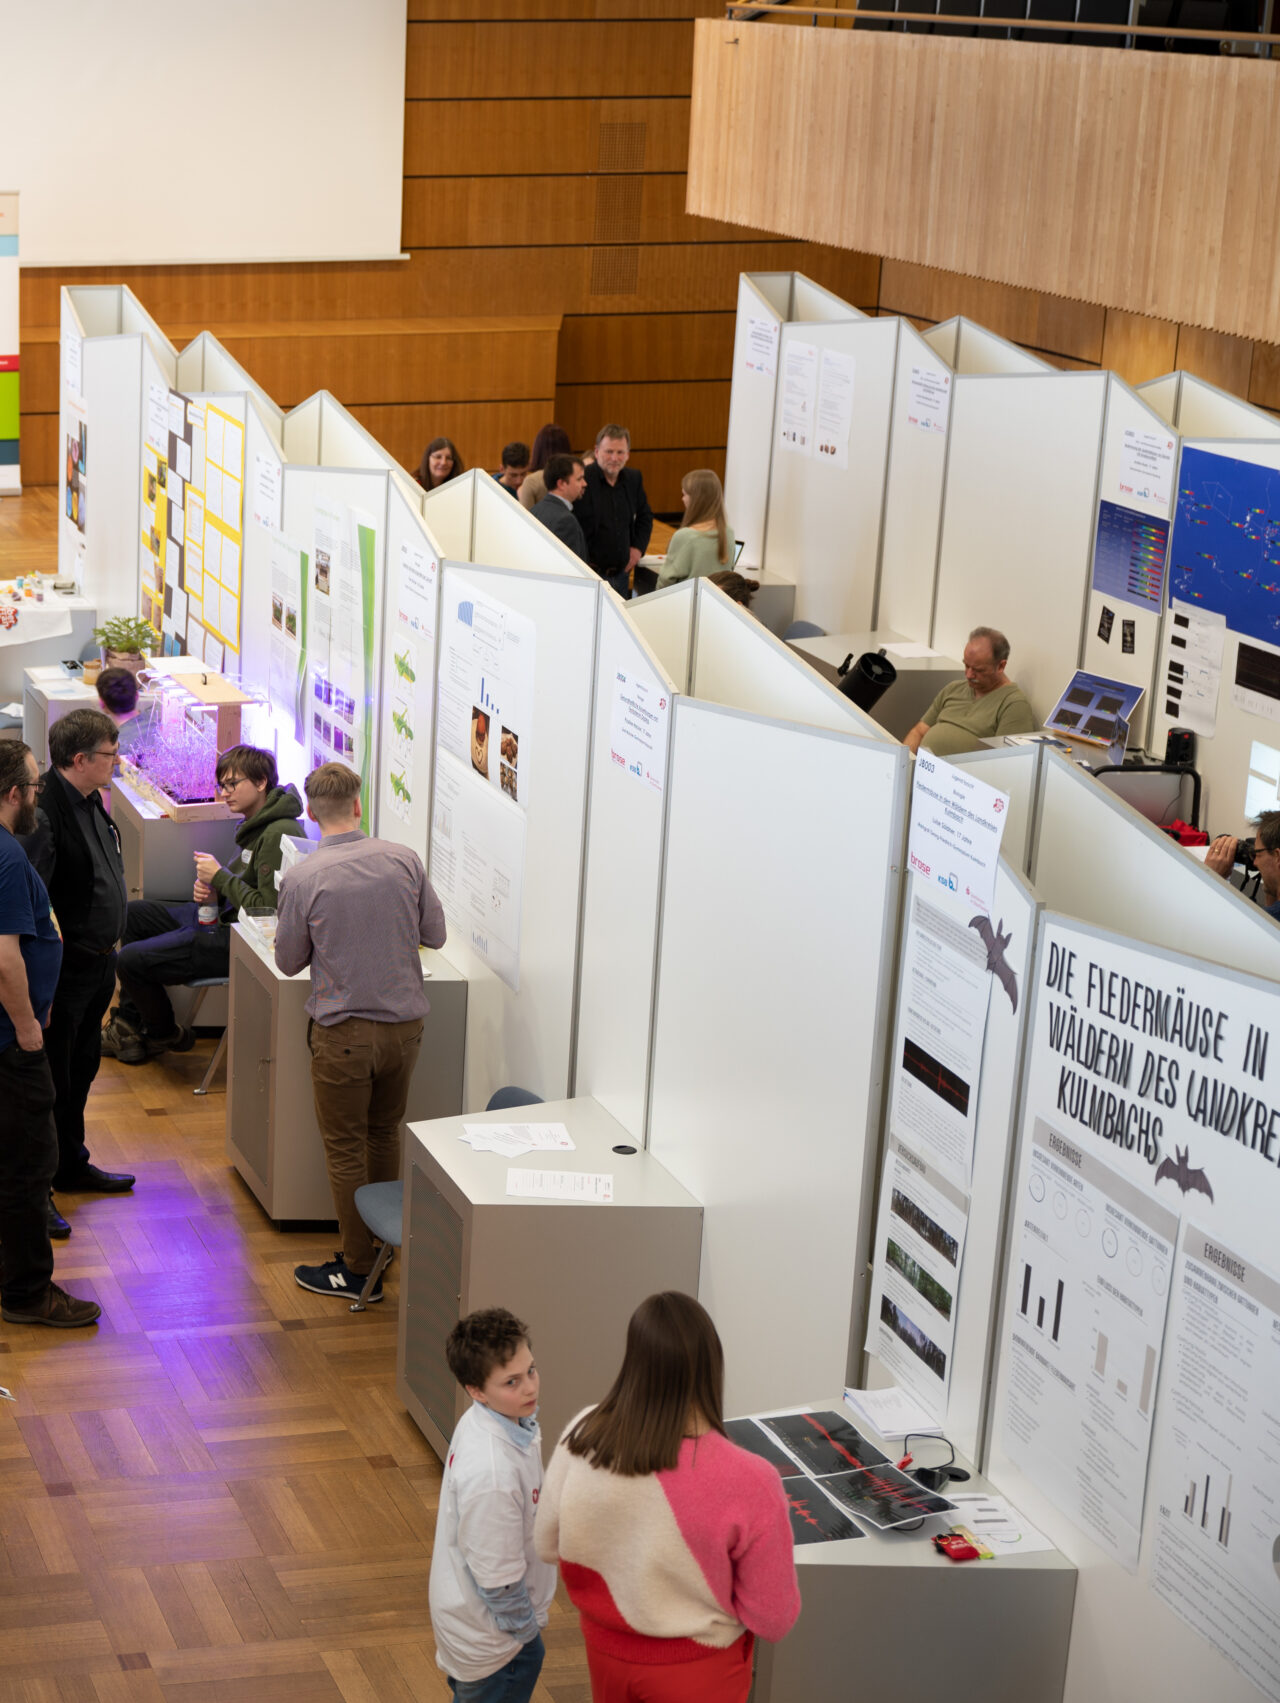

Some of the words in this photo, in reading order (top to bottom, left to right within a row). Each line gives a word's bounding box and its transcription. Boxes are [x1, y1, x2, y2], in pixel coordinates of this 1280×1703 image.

[918, 758, 935, 774] JB003
[910, 850, 931, 876] brose
[1046, 941, 1077, 999] DIE
[1087, 962, 1229, 1063] FLEDERMÄUSE
[1242, 1023, 1269, 1082] IN
[1049, 1001, 1134, 1089] WÄLDERN
[1138, 1049, 1180, 1109] DES
[1186, 1069, 1280, 1169] LANDKRE
[1057, 1065, 1164, 1166] KULMBACHS
[1049, 1132, 1082, 1169] ERGEBNISSE
[1203, 1242, 1246, 1283] ERGEBNISSE
